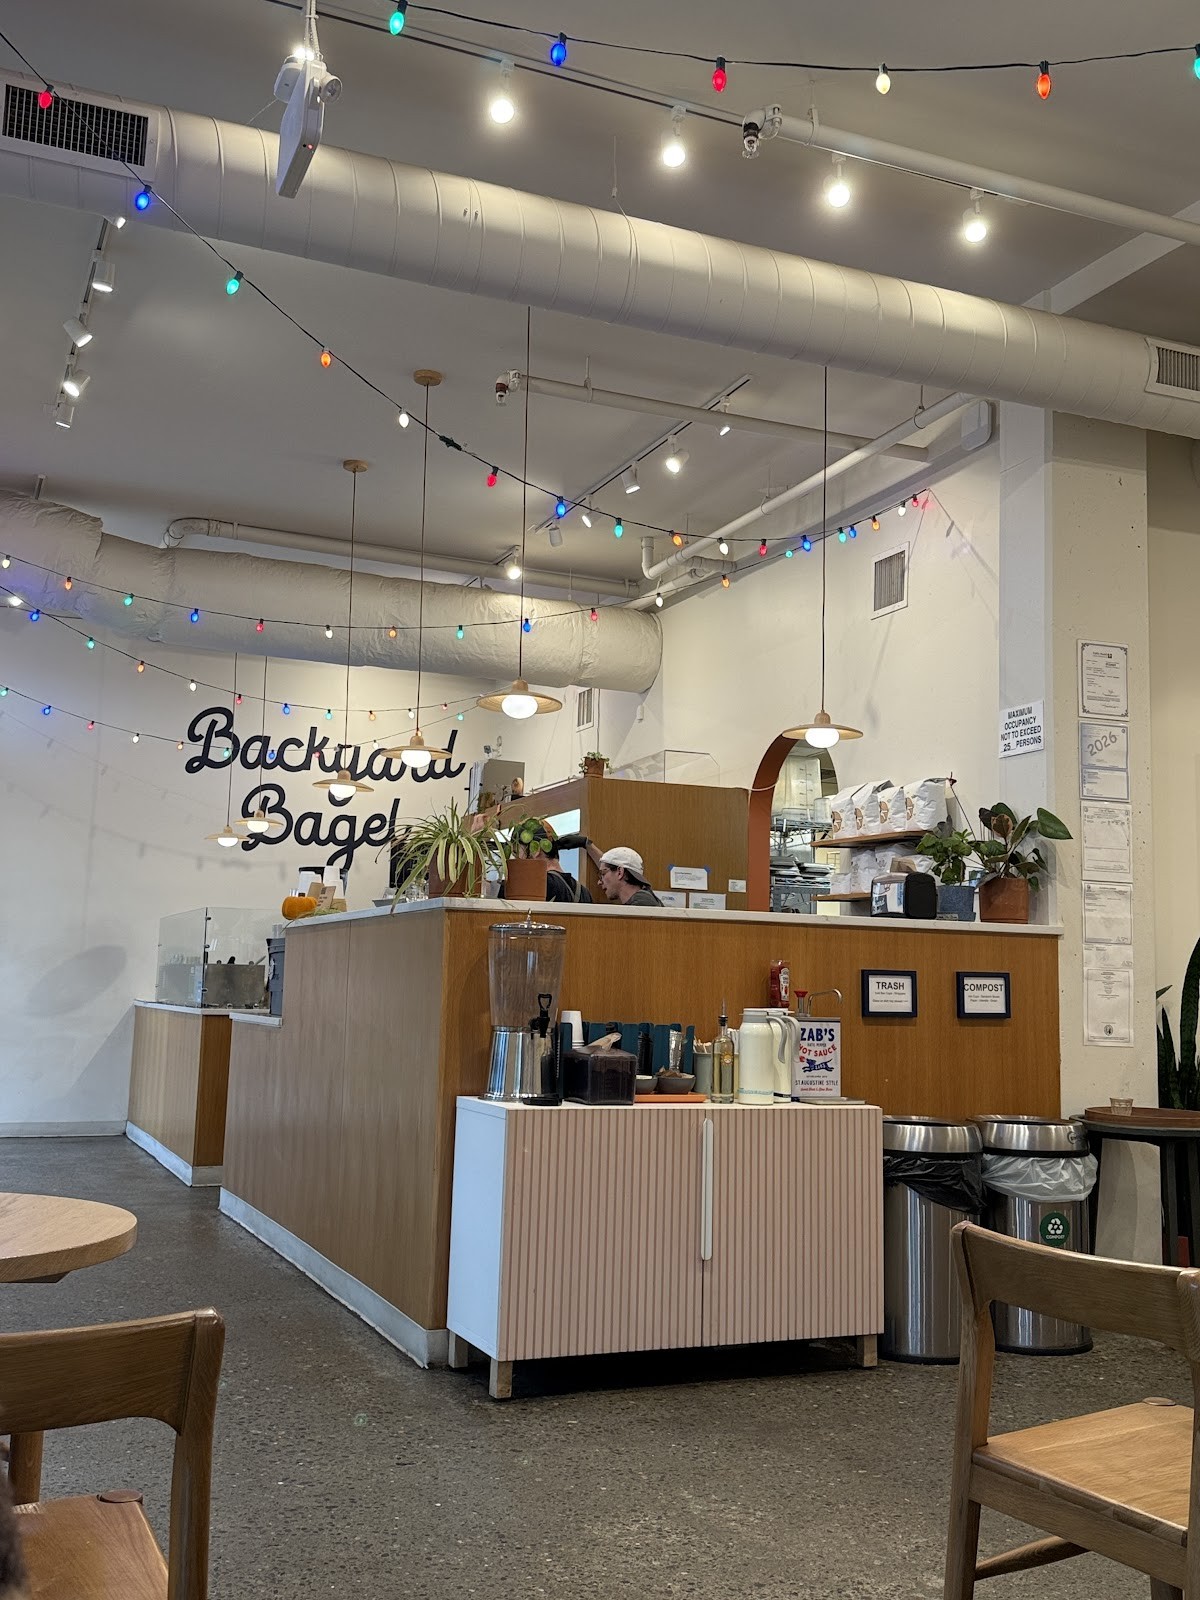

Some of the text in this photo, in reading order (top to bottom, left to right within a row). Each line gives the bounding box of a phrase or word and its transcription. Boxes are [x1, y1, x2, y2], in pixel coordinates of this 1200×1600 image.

[1007, 706, 1033, 720] MAXIMUM
[1004, 715, 1037, 731] OCCUPANCY
[1000, 725, 1042, 742] NOT TO EXCEED
[1003, 735, 1042, 752] 25 PERSONS
[1087, 731, 1118, 757] 2026
[875, 981, 905, 991] TRASH
[963, 983, 1004, 992] COMPOST
[800, 1027, 835, 1041] ZAB'S
[813, 1043, 838, 1057] SAUCE
